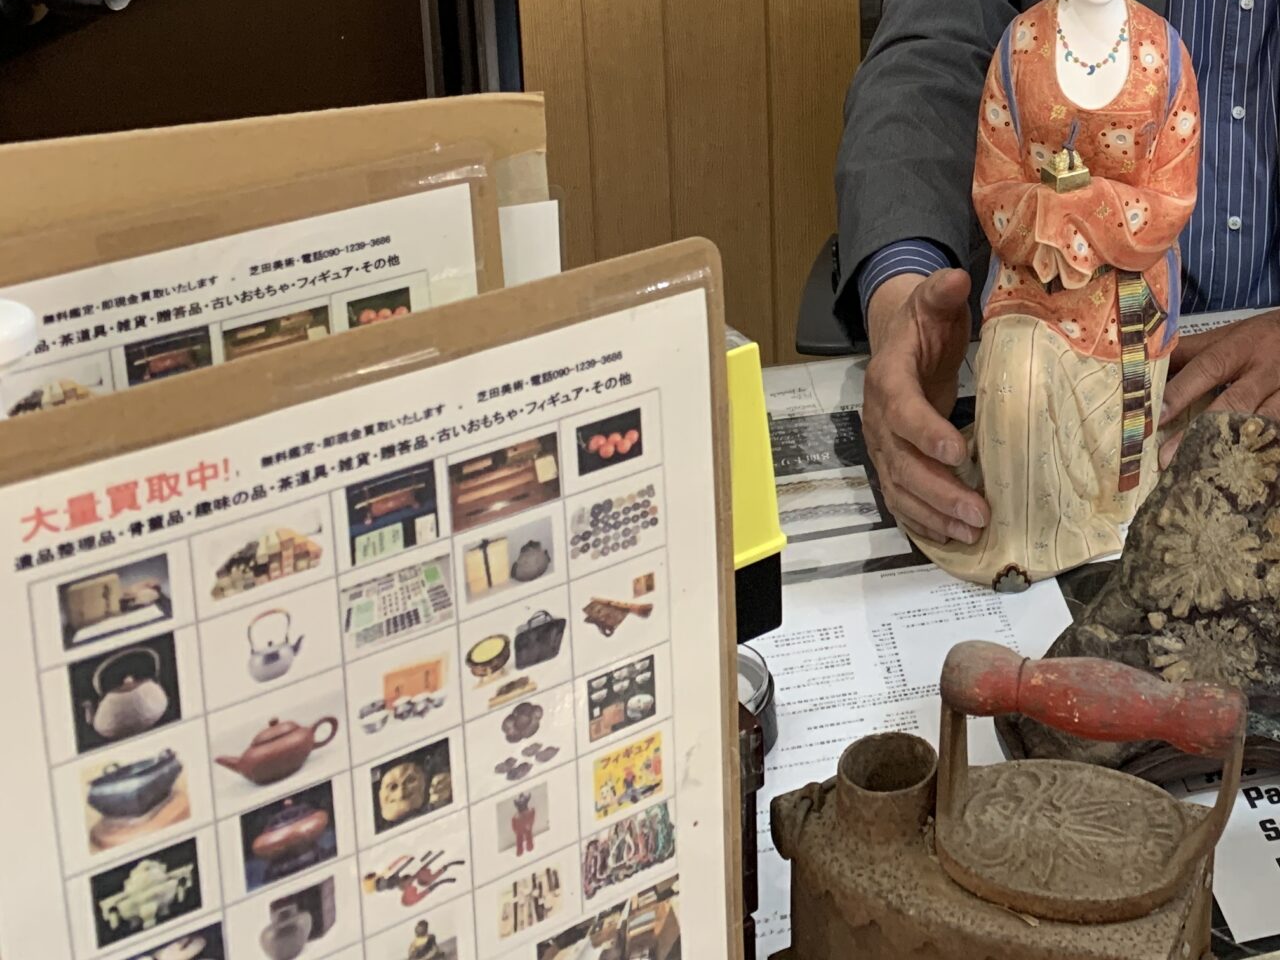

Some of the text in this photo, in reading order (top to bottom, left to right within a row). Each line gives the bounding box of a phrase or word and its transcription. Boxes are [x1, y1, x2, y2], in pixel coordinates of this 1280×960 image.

[20, 458, 230, 543] 大量買取中!
